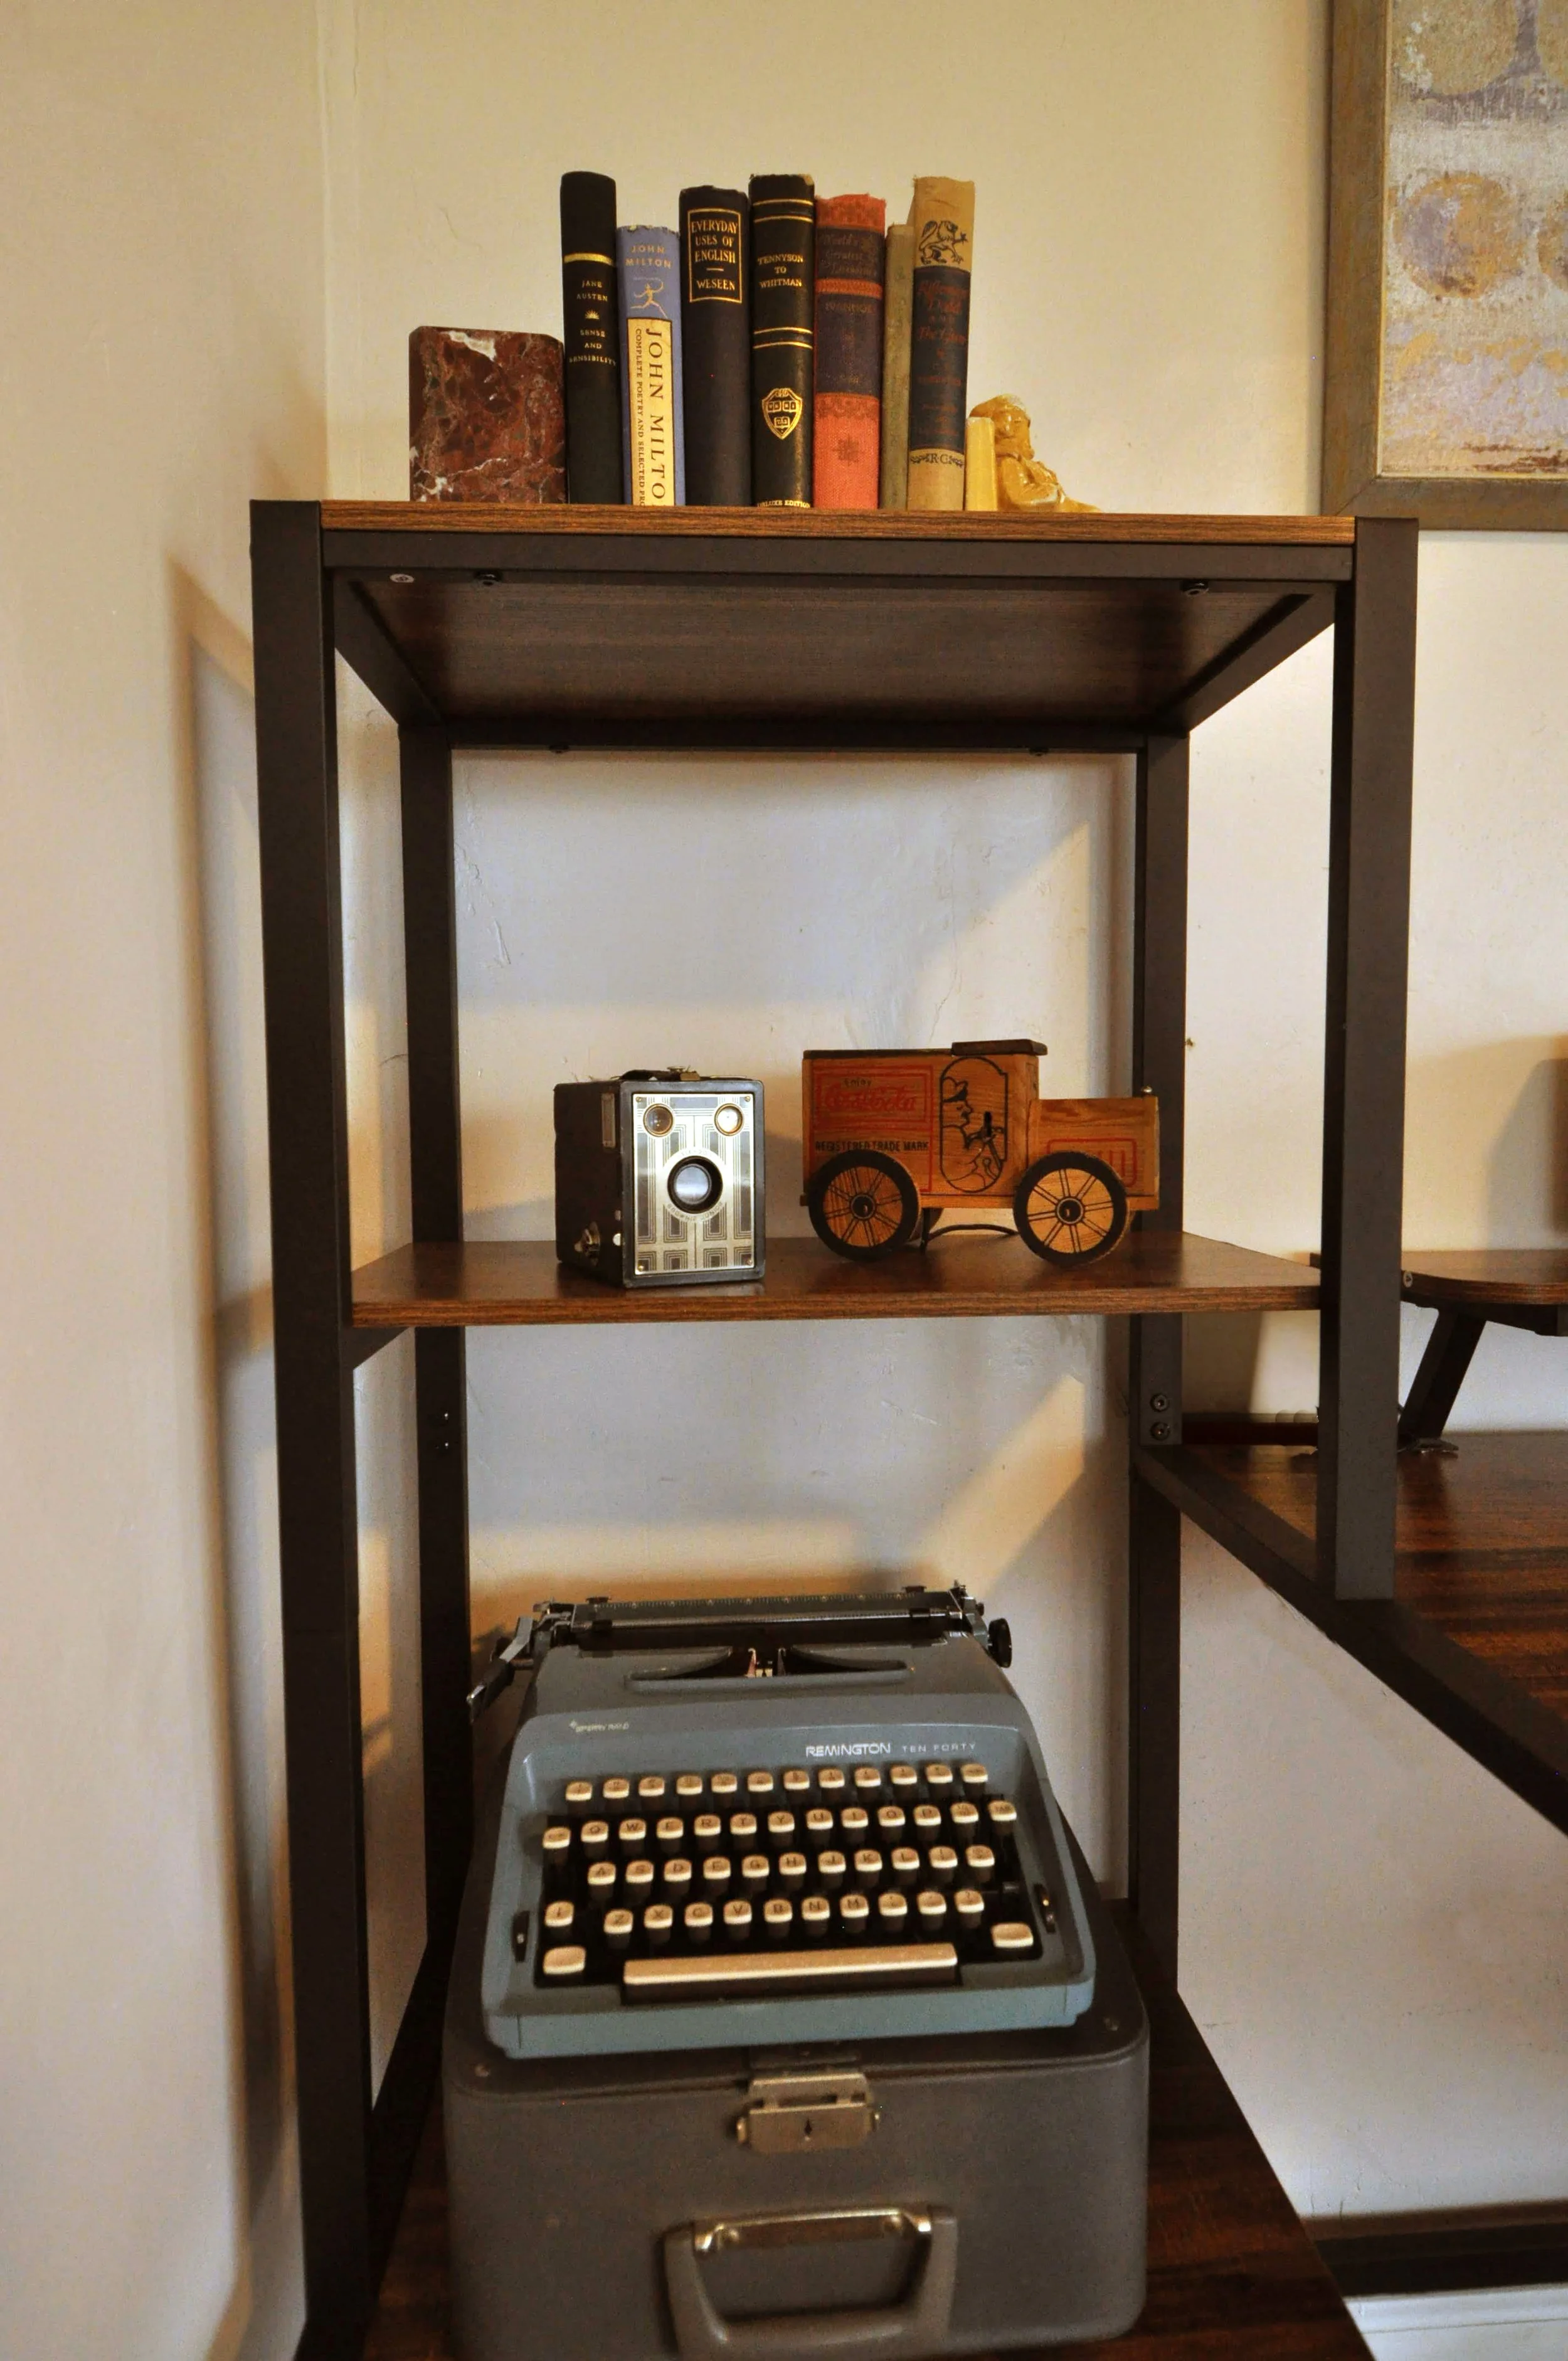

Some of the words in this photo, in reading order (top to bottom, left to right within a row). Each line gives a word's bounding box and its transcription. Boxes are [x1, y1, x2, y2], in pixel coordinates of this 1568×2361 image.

[691, 220, 738, 234] EVERYDAY
[696, 235, 718, 247] USES
[722, 236, 735, 247] OF
[631, 245, 665, 254] JOHN
[694, 248, 736, 263] ENGLISH
[625, 258, 673, 270] MILTON
[757, 253, 804, 265] TENNYSON
[774, 266, 787, 274] TO
[581, 279, 603, 289] JANE
[696, 278, 736, 292] WESEEN
[758, 277, 803, 289] WHITMAN
[576, 293, 608, 302] AUSTEN
[580, 329, 606, 337] SENSE
[584, 341, 603, 349] AND
[569, 354, 617, 366] SENSIBILITY
[646, 328, 663, 400] JOHN
[784, 500, 810, 509] EDITION
[872, 1141, 901, 1152] TRADE
[903, 1141, 930, 1151] MARK
[805, 1742, 891, 1758] REMINGTON
[902, 1745, 926, 1753] TEN
[933, 1741, 976, 1752] FORTY
